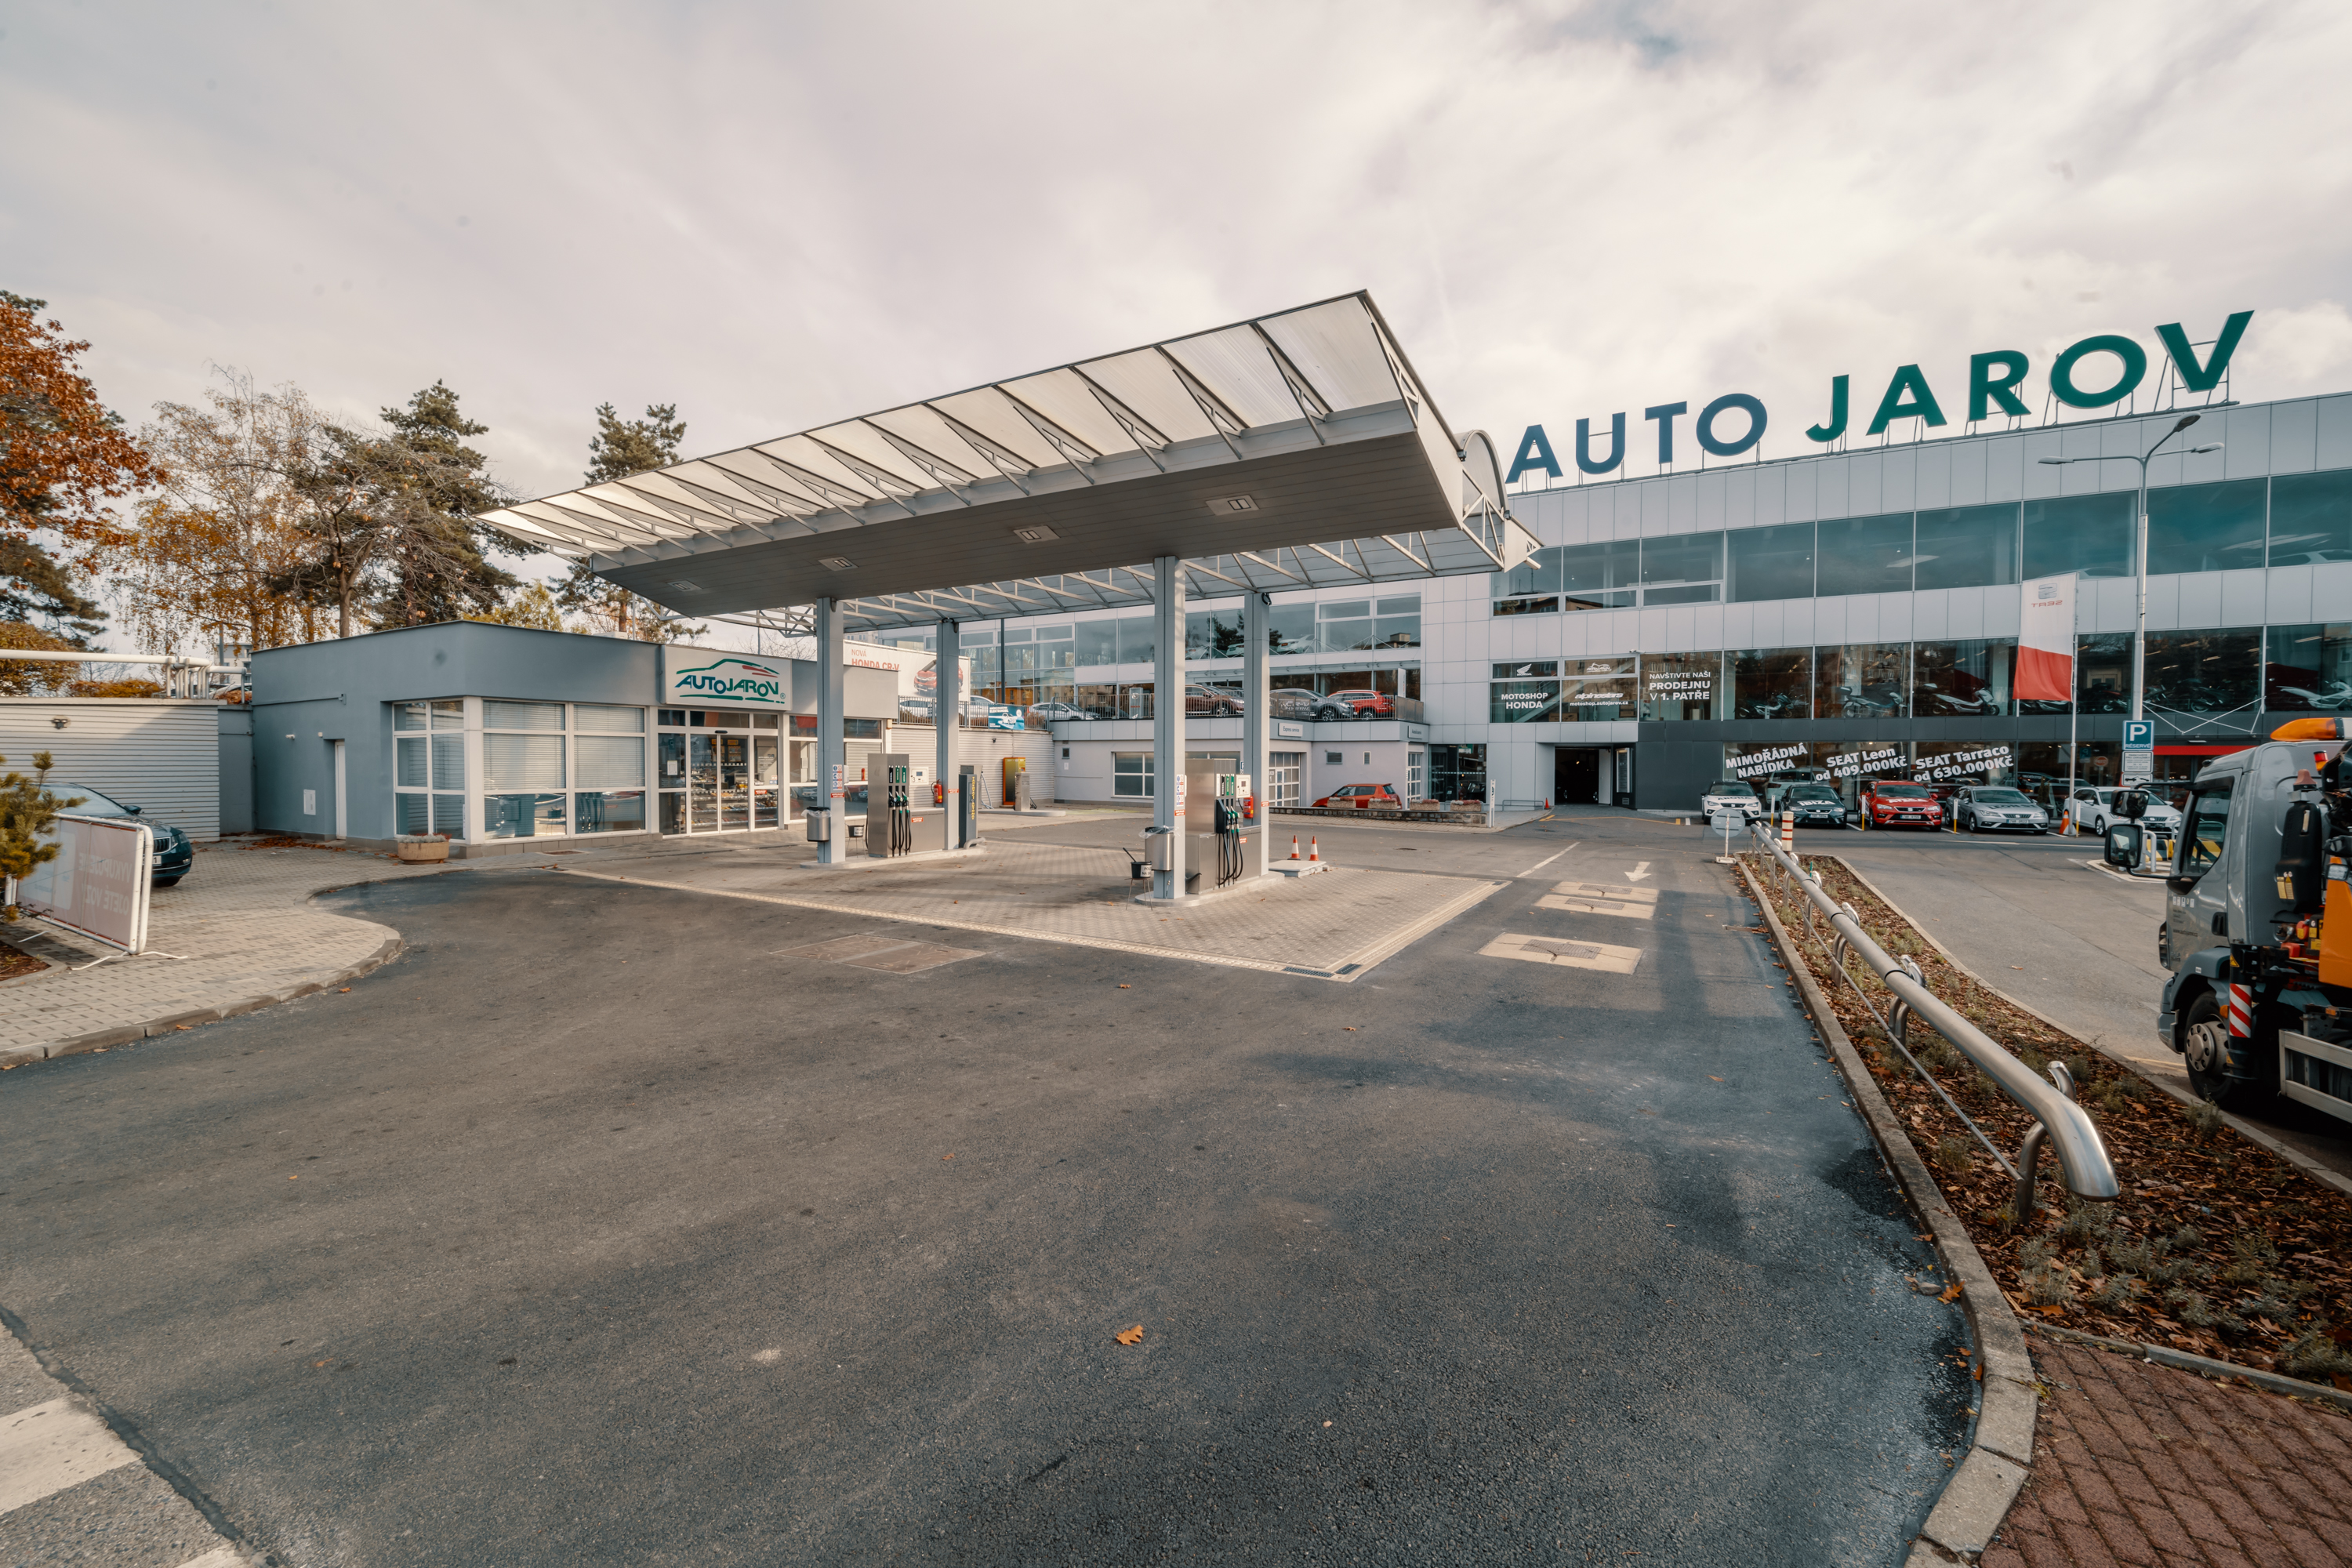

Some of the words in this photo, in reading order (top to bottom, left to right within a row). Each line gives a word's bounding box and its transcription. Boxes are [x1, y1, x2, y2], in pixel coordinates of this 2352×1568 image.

[1504, 393, 1768, 484] AUTO
[1805, 310, 2255, 443] JAROV
[851, 648, 867, 657] NOVÁ
[674, 674, 779, 697] AUTOJAROV
[1650, 681, 1711, 690] PRODEJNU
[1650, 692, 1658, 701] V
[1661, 692, 1670, 701] 1.
[1672, 689, 1710, 701] PATŘE
[1505, 701, 1544, 710] HONDA
[2129, 724, 2147, 742] P
[1726, 742, 1808, 769] MIMOŘÁDNÁ
[1826, 752, 1859, 768] SEAT
[1862, 748, 1896, 761] Leon
[1915, 753, 1951, 770] SEAT
[1953, 746, 2009, 763] Tarraco
[1737, 759, 1795, 779] NABÍDKA
[1815, 770, 1831, 782] od
[1833, 755, 1907, 778] 409.000Kč
[1914, 771, 1930, 782] od
[1933, 754, 2014, 779] 630.000Kč
